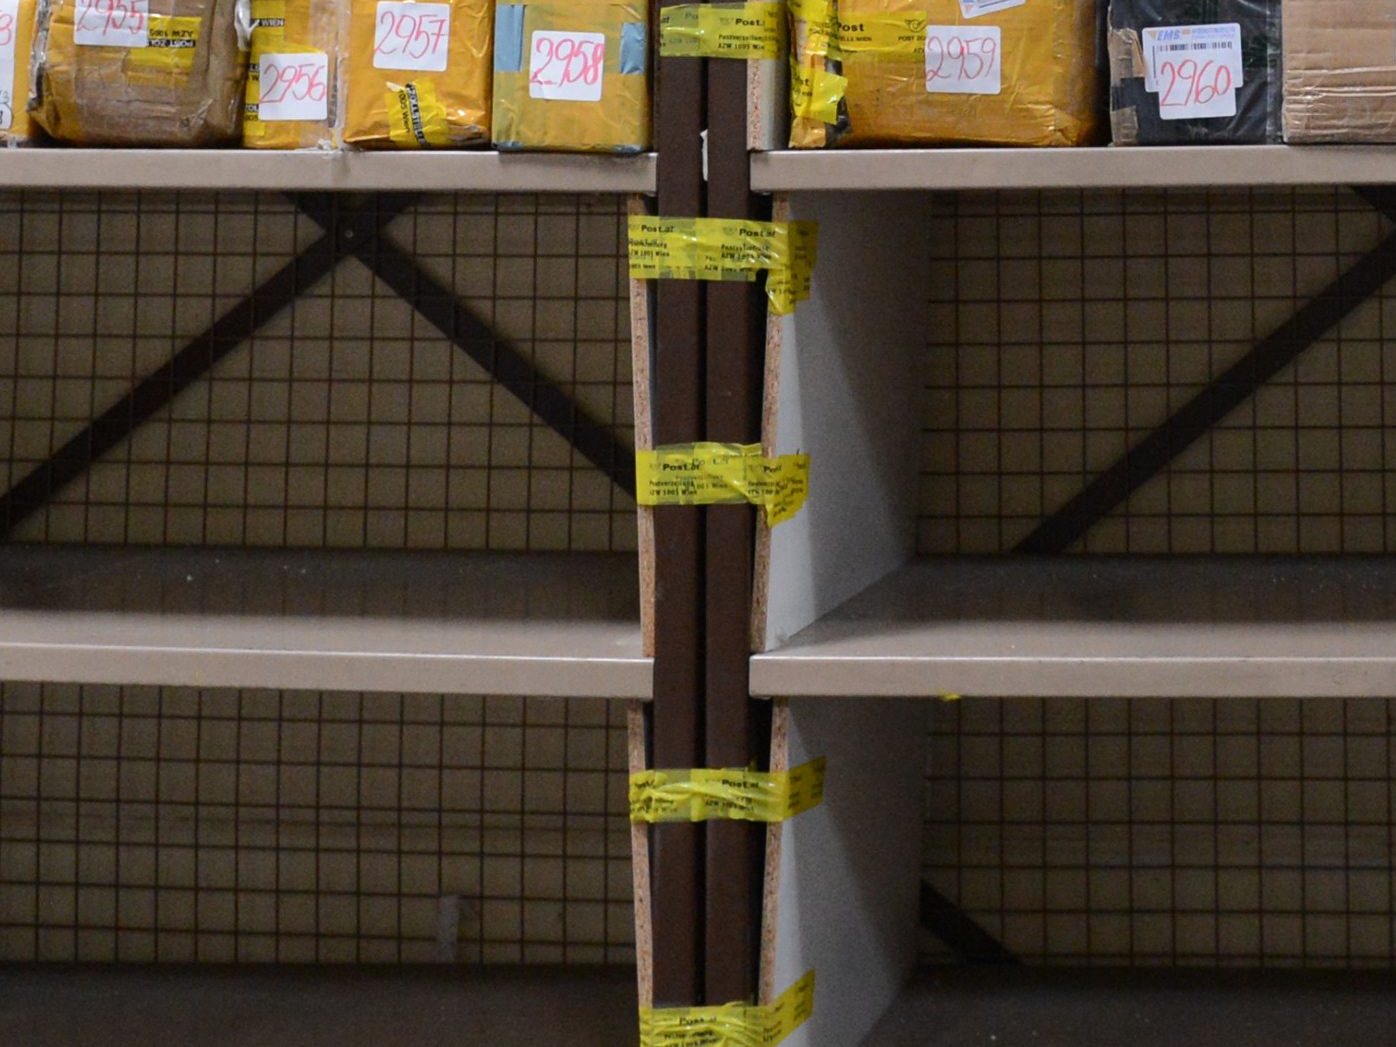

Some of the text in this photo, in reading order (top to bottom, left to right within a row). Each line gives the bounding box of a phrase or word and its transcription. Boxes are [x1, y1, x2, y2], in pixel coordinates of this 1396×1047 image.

[171, 29, 194, 37] AZW
[260, 18, 285, 27] WIEN
[374, 10, 449, 59] 2957
[1156, 28, 1181, 42] EMS
[169, 39, 194, 48] POST
[926, 36, 997, 81] 2959
[530, 36, 604, 87] 2958
[260, 62, 328, 104] 2956
[1159, 58, 1232, 108] 2960
[400, 112, 411, 134] Wien
